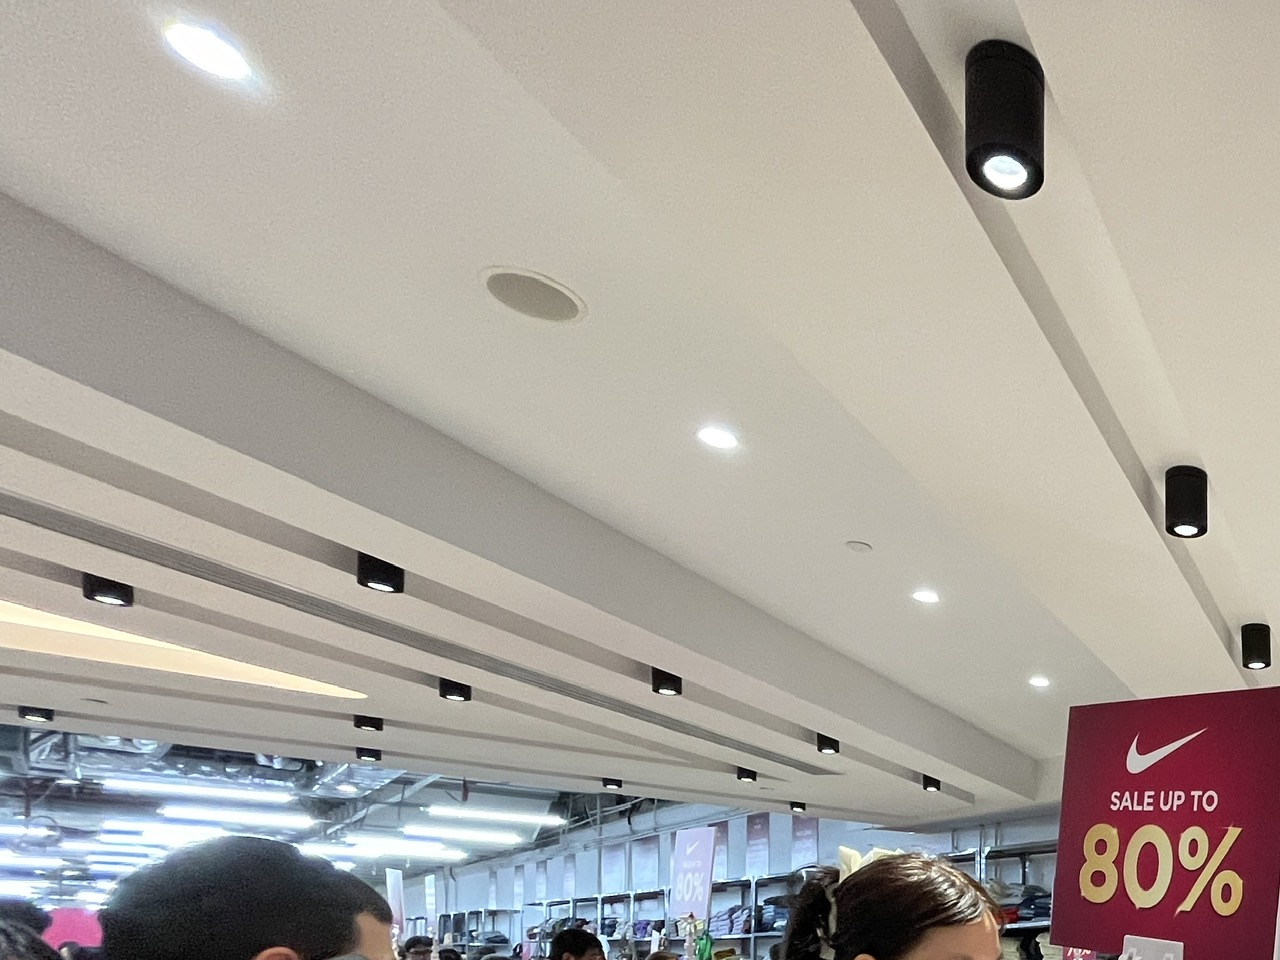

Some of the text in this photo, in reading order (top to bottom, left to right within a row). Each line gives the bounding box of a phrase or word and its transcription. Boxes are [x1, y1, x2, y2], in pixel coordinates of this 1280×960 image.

[1110, 790, 1219, 813] SALE UP TO
[1079, 822, 1244, 917] 80%
[675, 872, 704, 902] 80%
